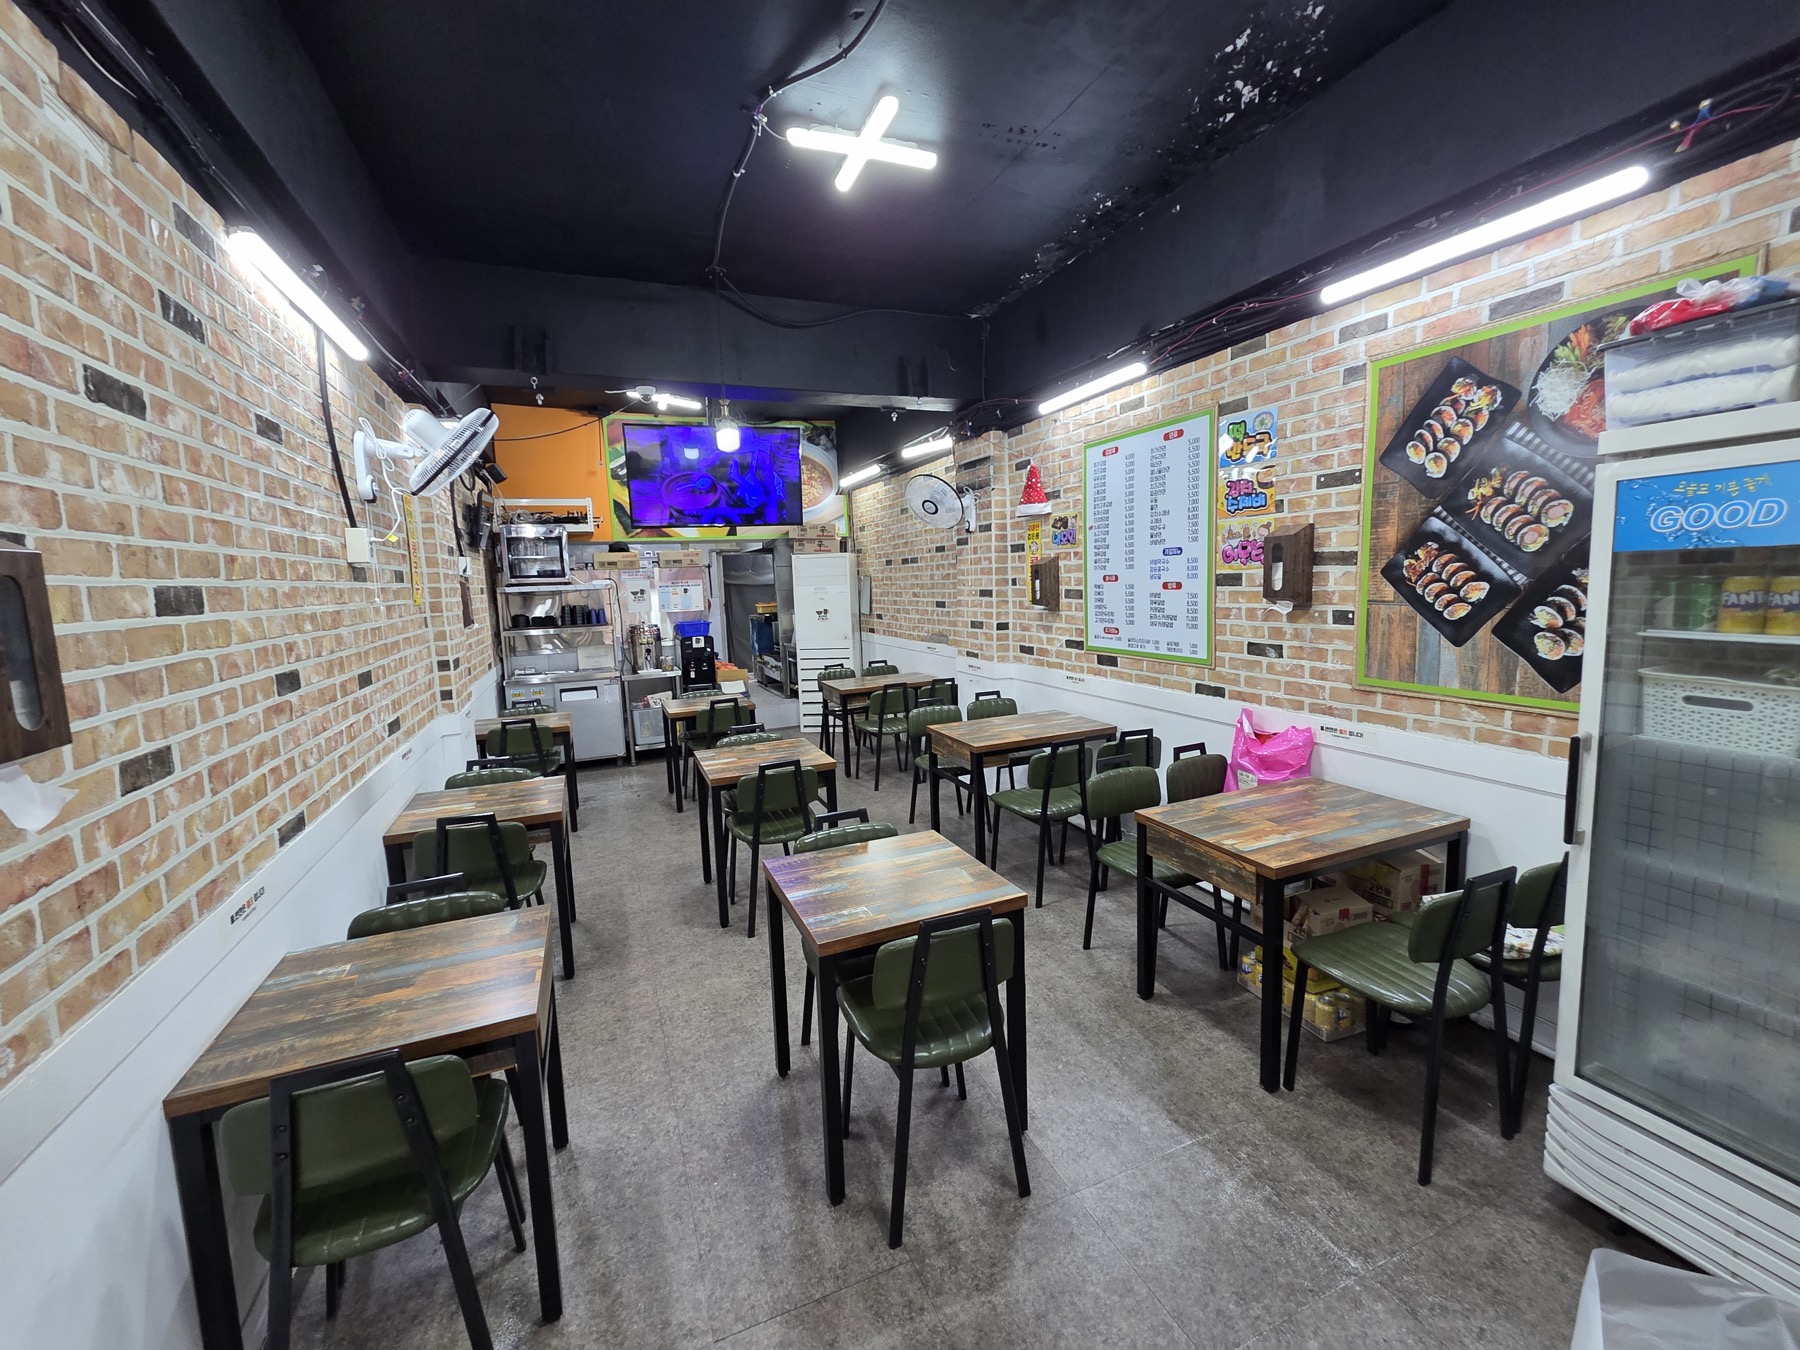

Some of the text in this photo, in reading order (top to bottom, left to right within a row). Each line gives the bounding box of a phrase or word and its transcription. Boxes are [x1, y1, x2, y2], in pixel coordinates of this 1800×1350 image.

[1228, 421, 1246, 441] 떡
[1188, 437, 1200, 446] 5,000
[1188, 444, 1200, 453] 5,500
[1188, 452, 1200, 461] 5,500
[1125, 460, 1135, 468] 5,000
[1188, 460, 1200, 468] 5,500
[1188, 467, 1200, 476] 5,500
[1187, 475, 1200, 483] 5,500
[1187, 483, 1200, 491] 5,500
[1226, 479, 1254, 497] 김치
[1673, 481, 1709, 497] 오늘도
[1187, 490, 1200, 498] 5,500
[1188, 498, 1199, 506] 7,000
[1226, 492, 1267, 514] 수제비
[1187, 505, 1199, 513] 8,000
[1187, 513, 1199, 521] 8,000
[1650, 498, 1788, 532] GOOD
[1722, 591, 1766, 605] FANT
[1769, 590, 1800, 606] FAN
